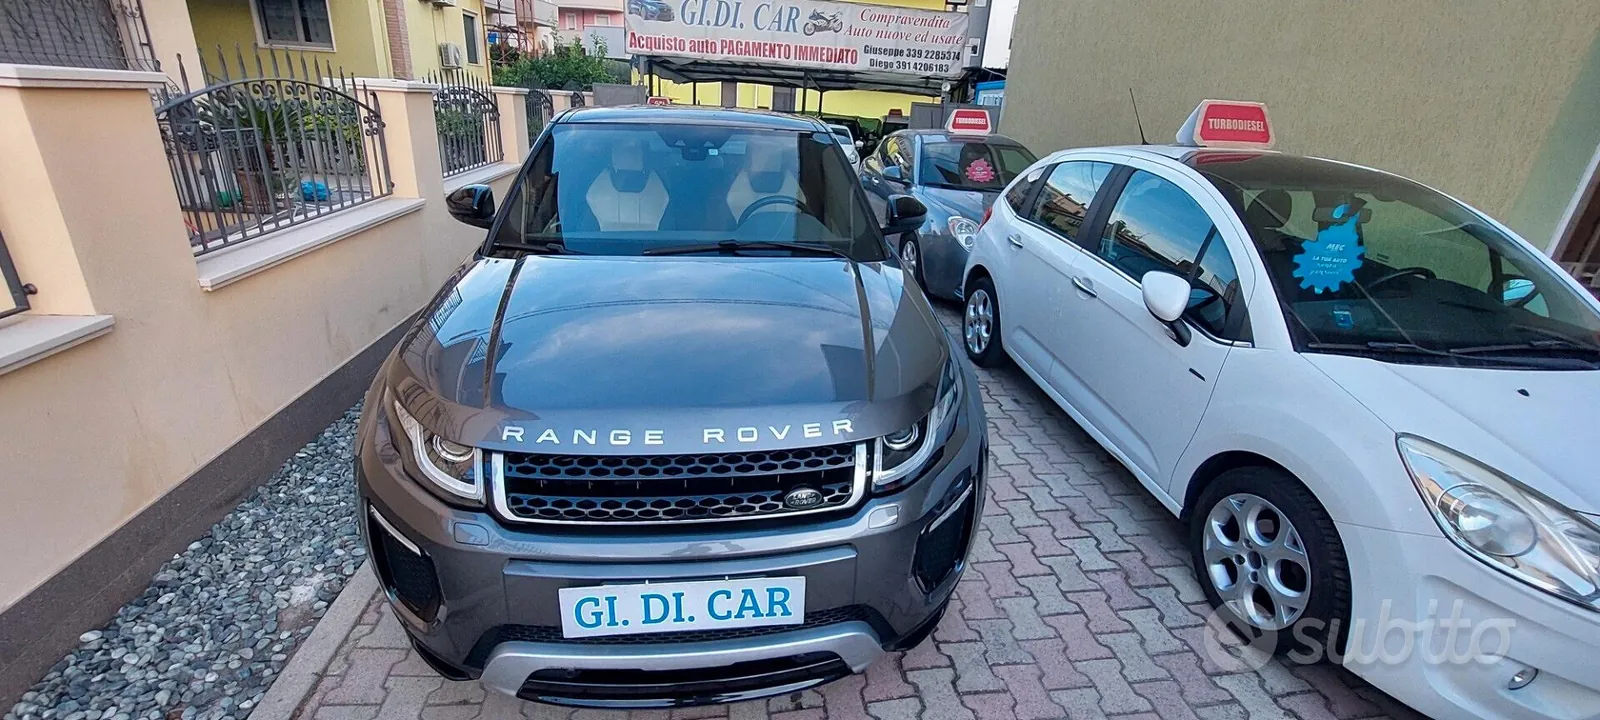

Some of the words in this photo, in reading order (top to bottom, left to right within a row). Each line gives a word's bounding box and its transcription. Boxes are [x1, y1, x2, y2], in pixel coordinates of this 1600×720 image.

[753, 4, 800, 33] CAR
[860, 8, 950, 29] Compravendita
[844, 24, 873, 37] Auto
[875, 29, 911, 41] nuove
[914, 31, 928, 43] ed
[931, 34, 963, 45] usate
[629, 31, 686, 52] Acquisto
[689, 39, 717, 54] auto
[720, 39, 791, 60] PAGAMENTO
[794, 45, 858, 65] IMMEDIATO
[864, 45, 905, 58] Giuseppe
[906, 48, 922, 59] 339
[924, 50, 961, 61] 2285374
[869, 58, 894, 70] Diego
[895, 61, 911, 70] 391
[912, 62, 949, 73] 4206183
[1208, 118, 1265, 132] TURBODIESEL
[502, 426, 664, 445] RANGE
[703, 419, 854, 443] ROVER
[574, 596, 630, 629] GI.
[641, 592, 696, 625] DI.
[707, 587, 793, 621] CAR
